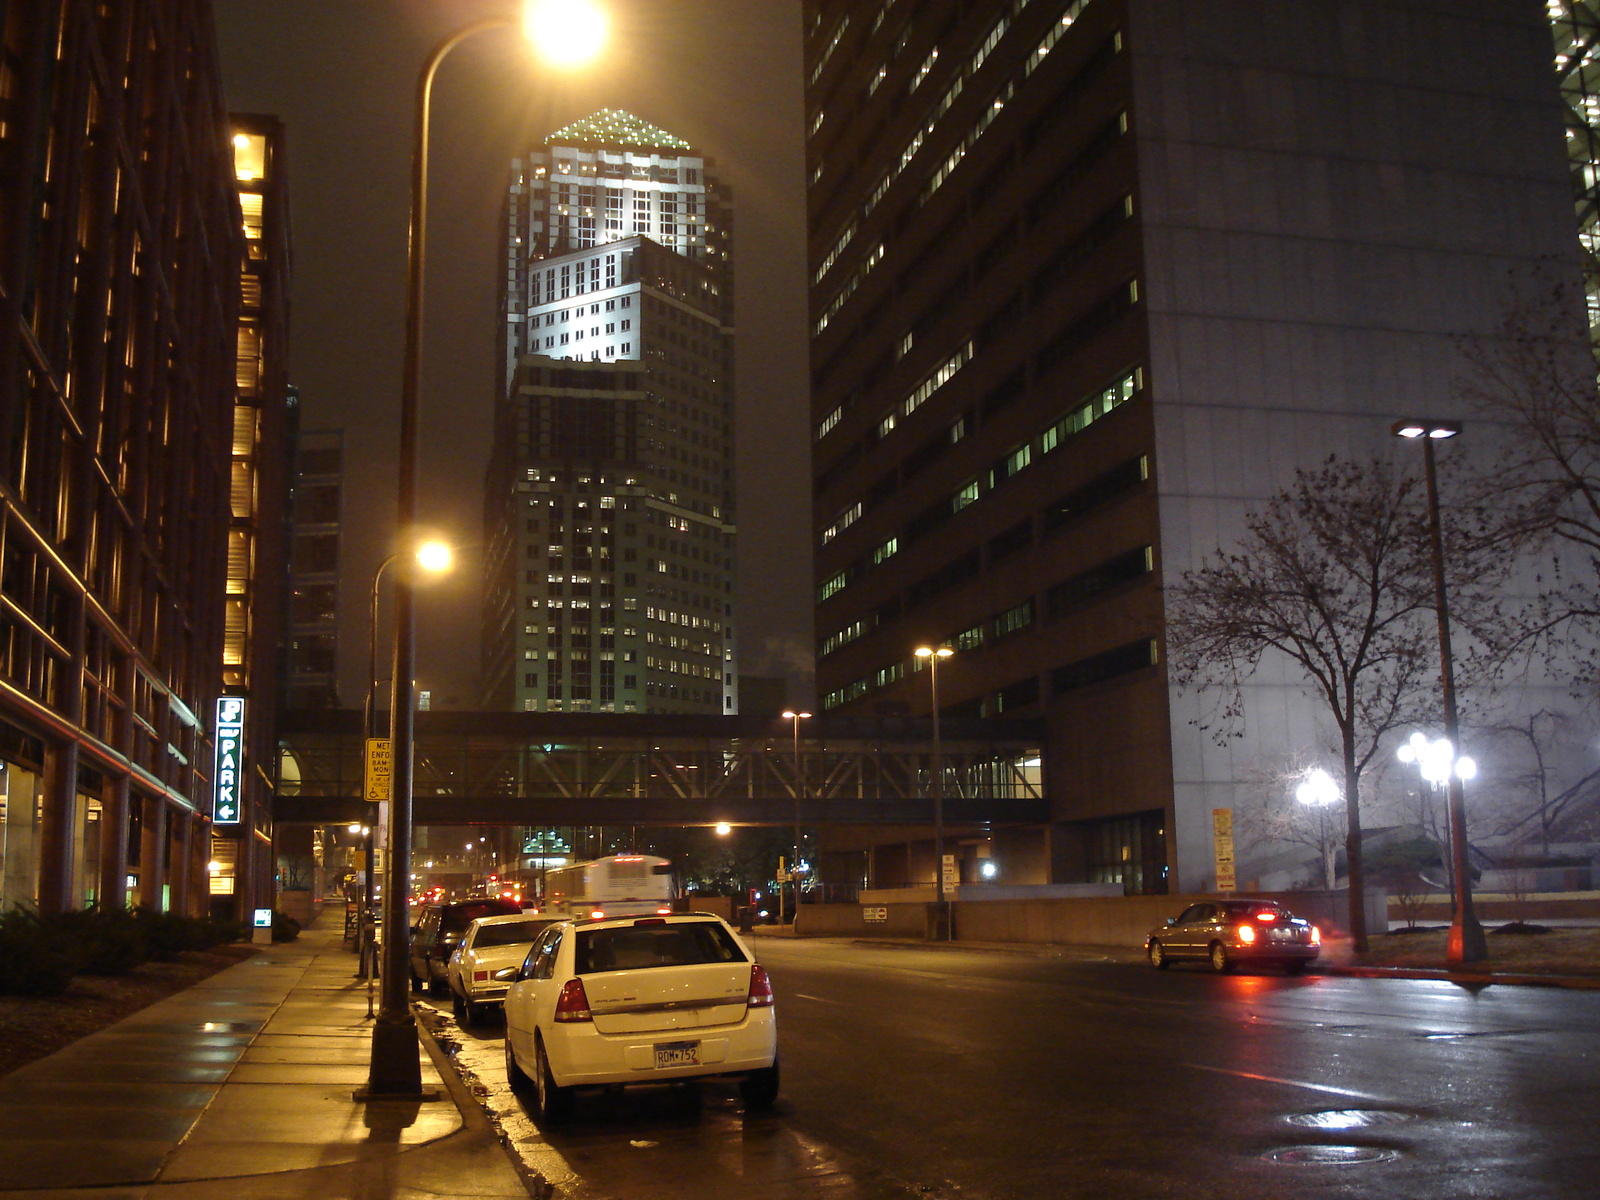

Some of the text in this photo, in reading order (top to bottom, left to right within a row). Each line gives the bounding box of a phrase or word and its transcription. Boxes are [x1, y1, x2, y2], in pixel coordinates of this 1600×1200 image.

[376, 742, 390, 750] MET
[371, 751, 390, 759] ENFO
[220, 739, 235, 802] PARK
